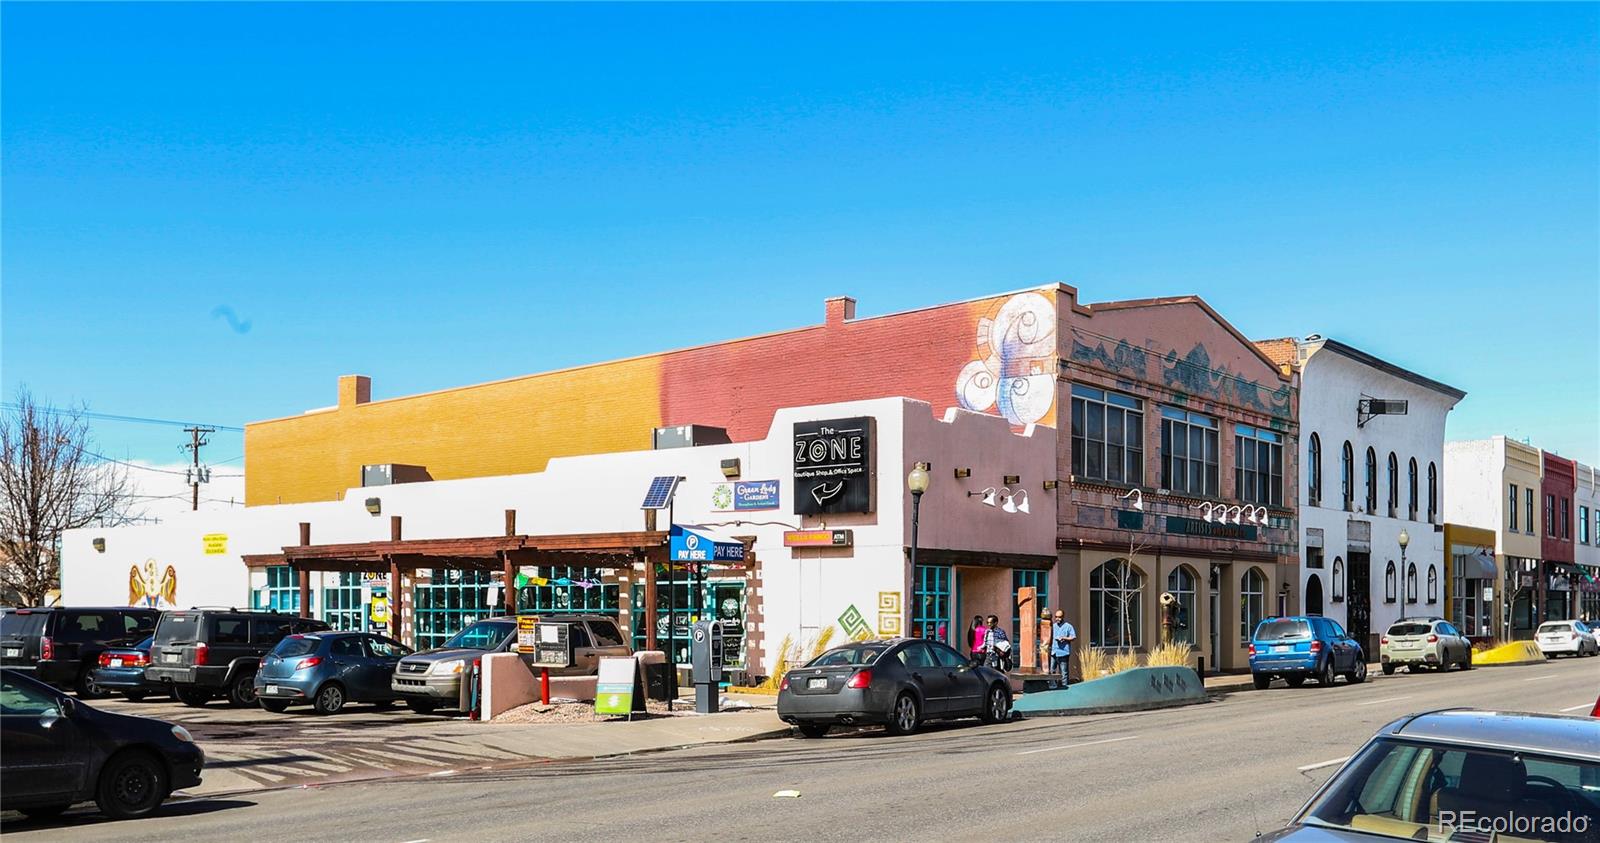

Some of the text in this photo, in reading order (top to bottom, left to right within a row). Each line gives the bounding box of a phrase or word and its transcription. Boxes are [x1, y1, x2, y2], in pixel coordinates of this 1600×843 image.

[821, 427, 835, 435] The
[795, 436, 861, 463] ZONE
[737, 482, 777, 495] Green Lady
[1186, 520, 1212, 535] ARTISTS
[678, 550, 706, 560] PAY HERE
[714, 545, 743, 558] PAY HERE
